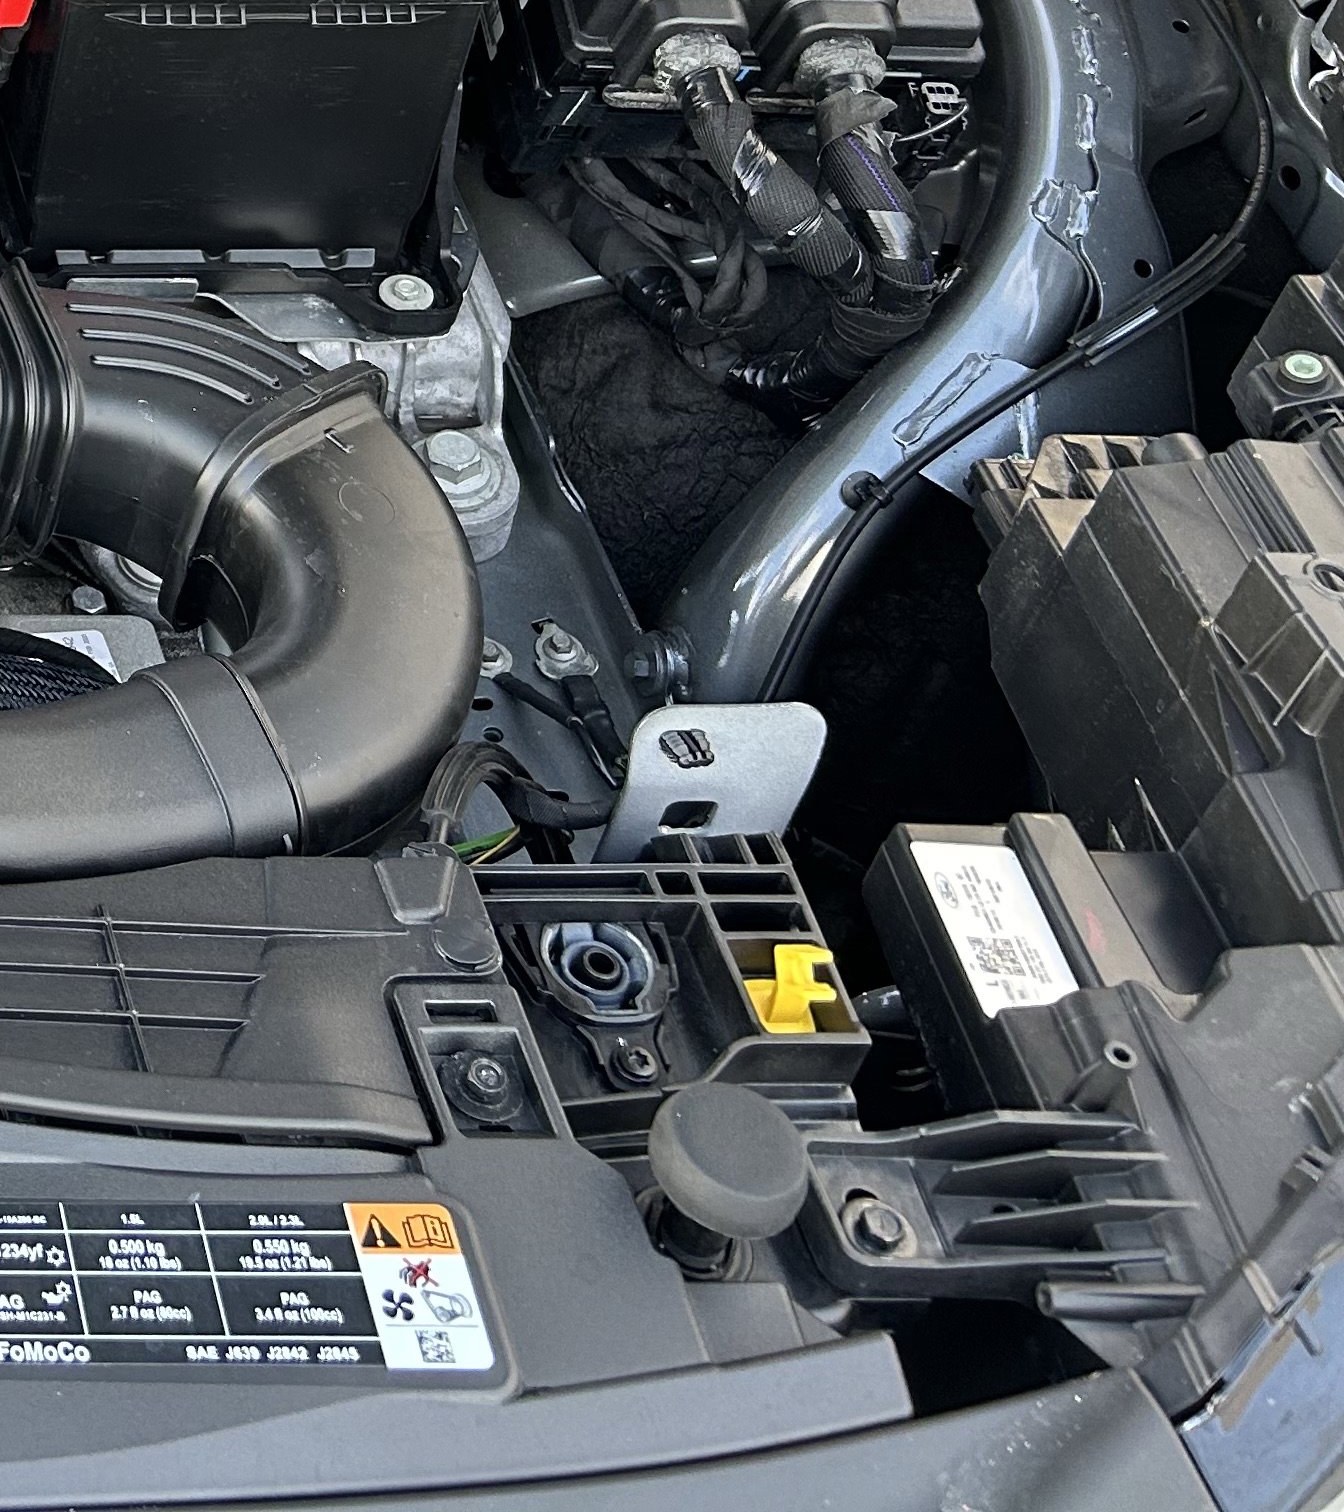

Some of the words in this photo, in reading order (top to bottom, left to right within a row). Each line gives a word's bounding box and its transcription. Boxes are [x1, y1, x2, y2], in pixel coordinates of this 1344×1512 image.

[108, 1239, 145, 1255] 0.500
[146, 1239, 166, 1258] kg
[252, 1239, 290, 1255] 0.550
[290, 1239, 311, 1258] kg
[133, 1289, 163, 1305] PAG
[280, 1291, 311, 1306] PAG
[110, 1305, 129, 1320] 2.7
[185, 1344, 220, 1361] SAE
